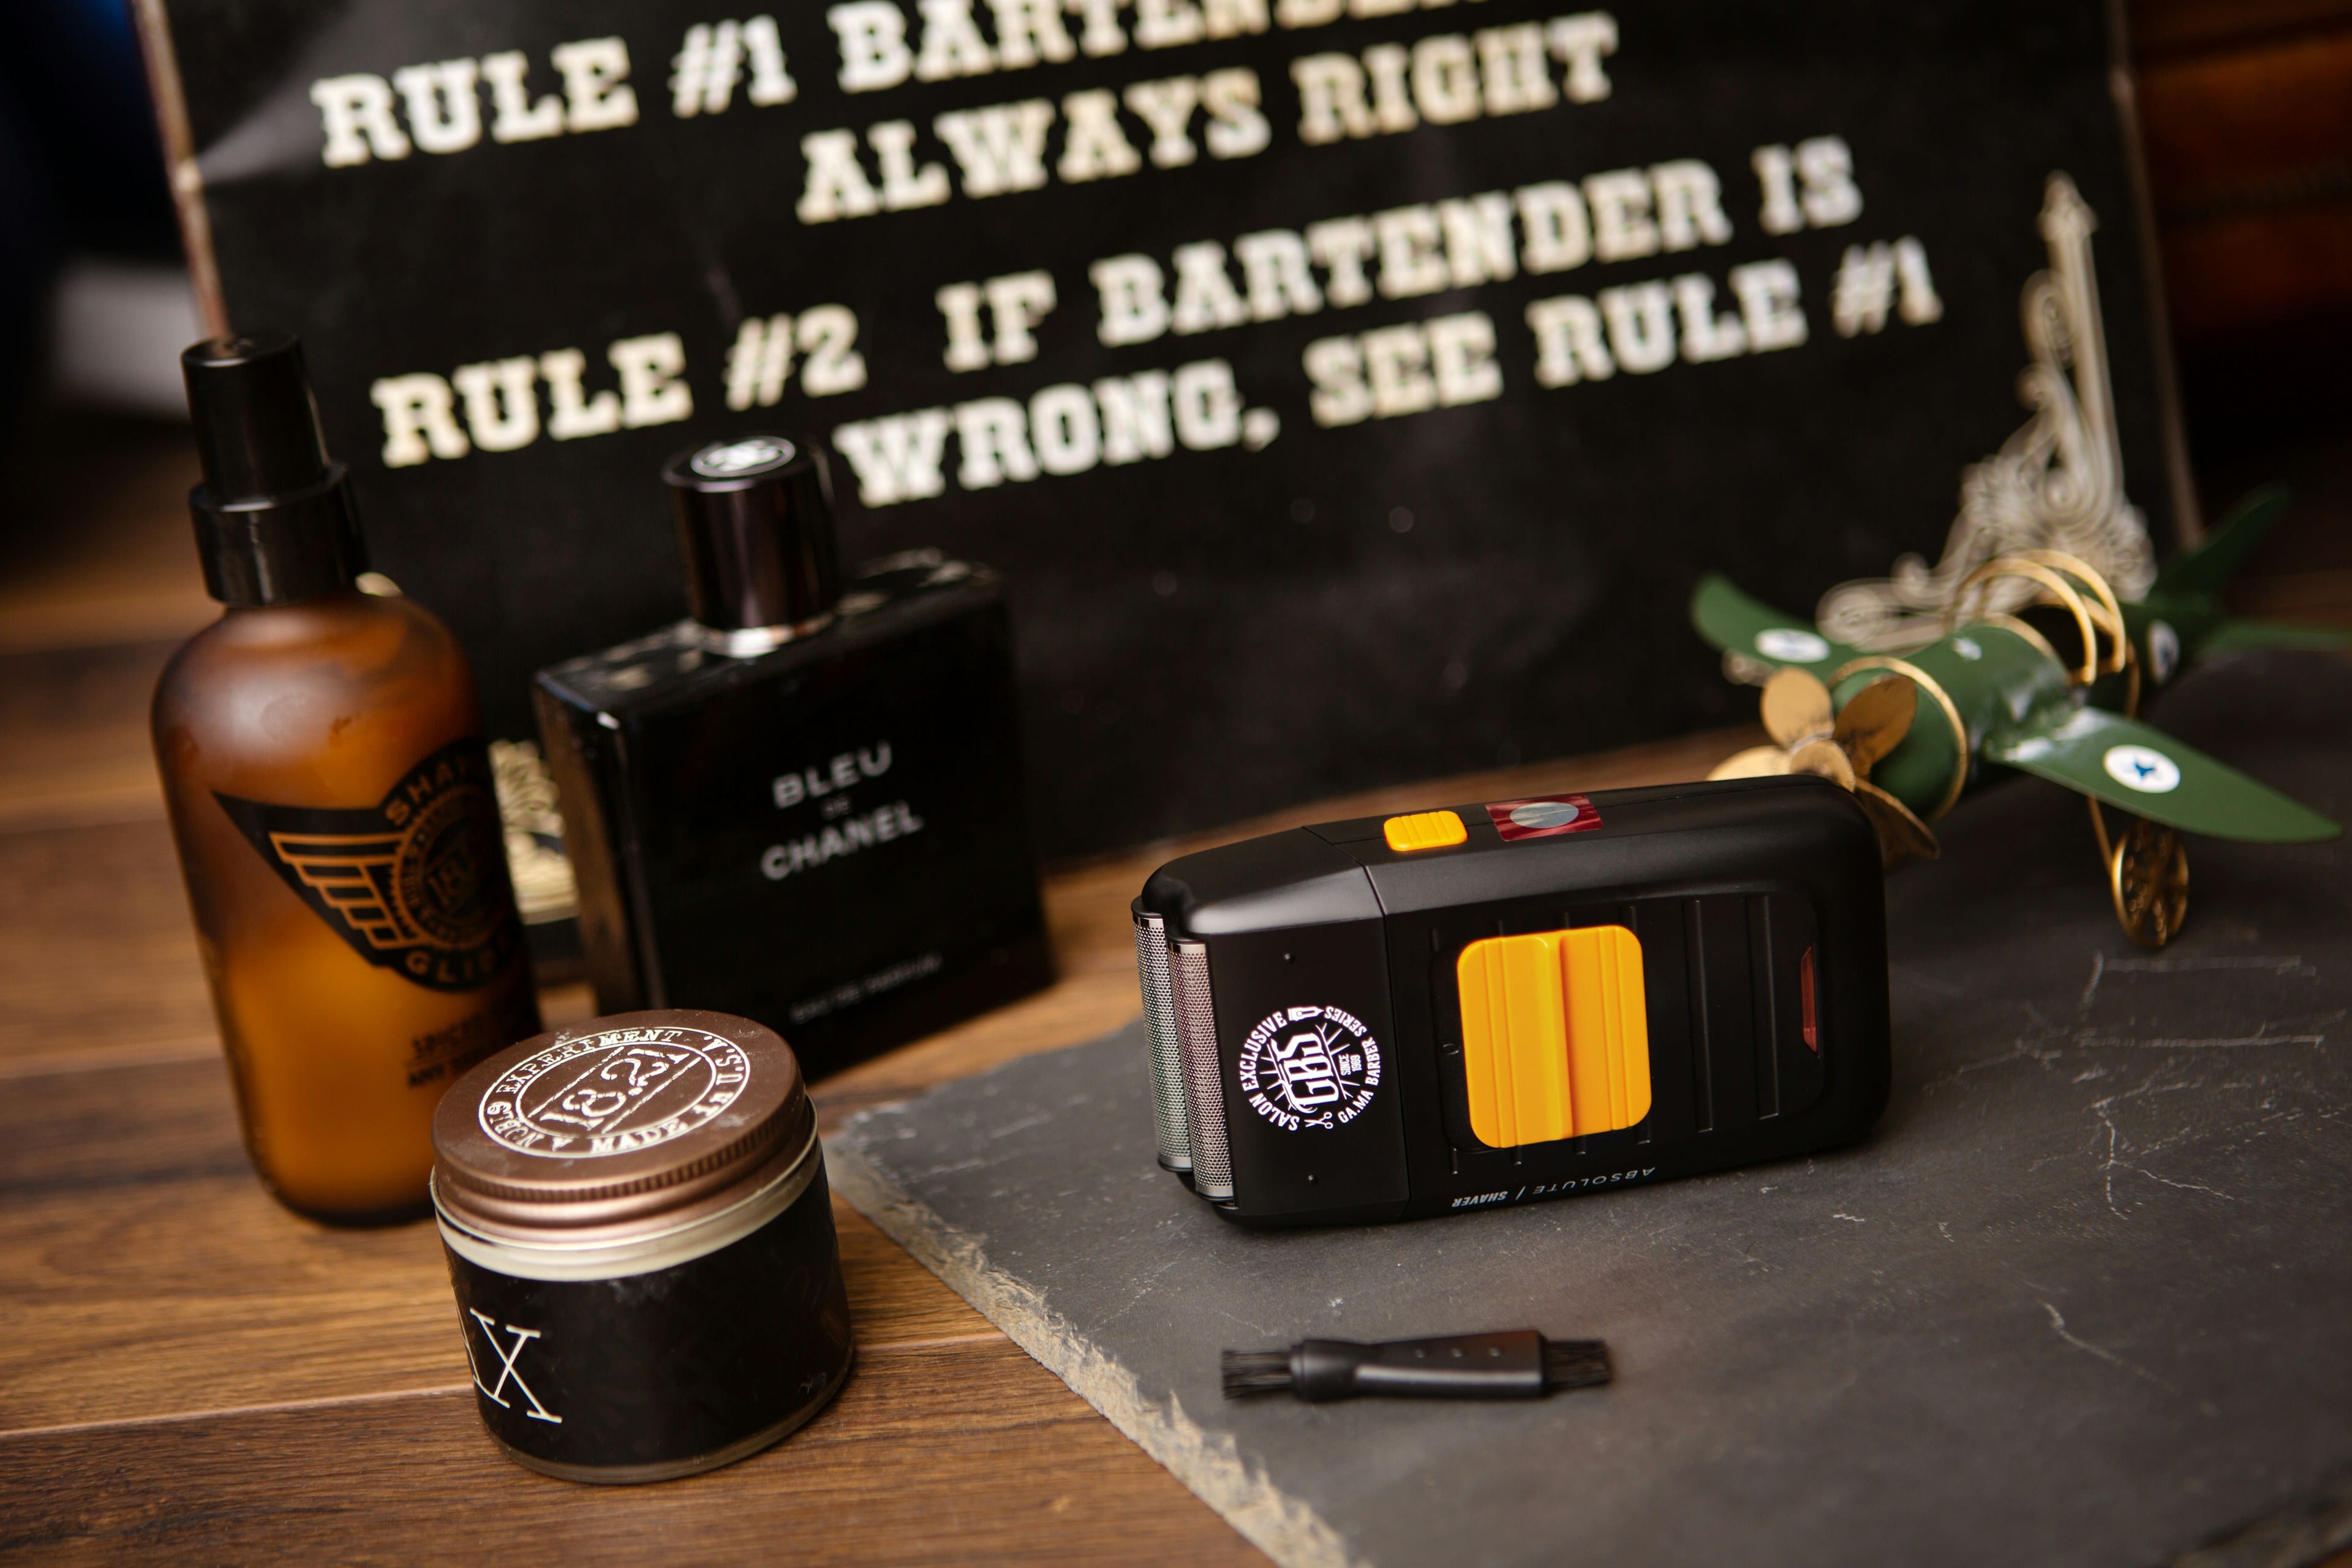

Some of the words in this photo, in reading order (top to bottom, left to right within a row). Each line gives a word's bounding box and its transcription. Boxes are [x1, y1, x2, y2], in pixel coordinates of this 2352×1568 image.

[309, 36, 639, 168] RULE
[669, 15, 797, 118] #1
[827, 0, 1458, 92] BARTE
[796, 65, 1270, 224] ALWAYS
[1291, 12, 1618, 145] RIGHT
[370, 333, 693, 468] RULE
[725, 304, 867, 411] #2
[936, 271, 1057, 372] IF
[1090, 159, 1732, 347] BARTENDER
[1752, 136, 1862, 234] IS
[832, 359, 1280, 508] WRONG,
[1303, 311, 1503, 426] SEE
[1526, 260, 1807, 388] RULE
[1831, 237, 1942, 336] #1
[772, 741, 892, 809] BLEU
[761, 800, 924, 880] CHANEL
[1239, 1011, 1287, 1091] EXCLUSIVE
[1324, 1006, 1368, 1038] SERIES
[496, 1028, 684, 1094] EXPERIMENT
[1337, 1089, 1374, 1124] GA.MA
[1361, 1036, 1381, 1087] BARBER
[1338, 1054, 1352, 1076] SINCE
[1349, 1054, 1362, 1072] 1969
[1249, 1093, 1300, 1131] SALON
[1451, 1190, 1509, 1208] SHAVER
[1532, 1166, 1656, 1195] ABSOLUTE
